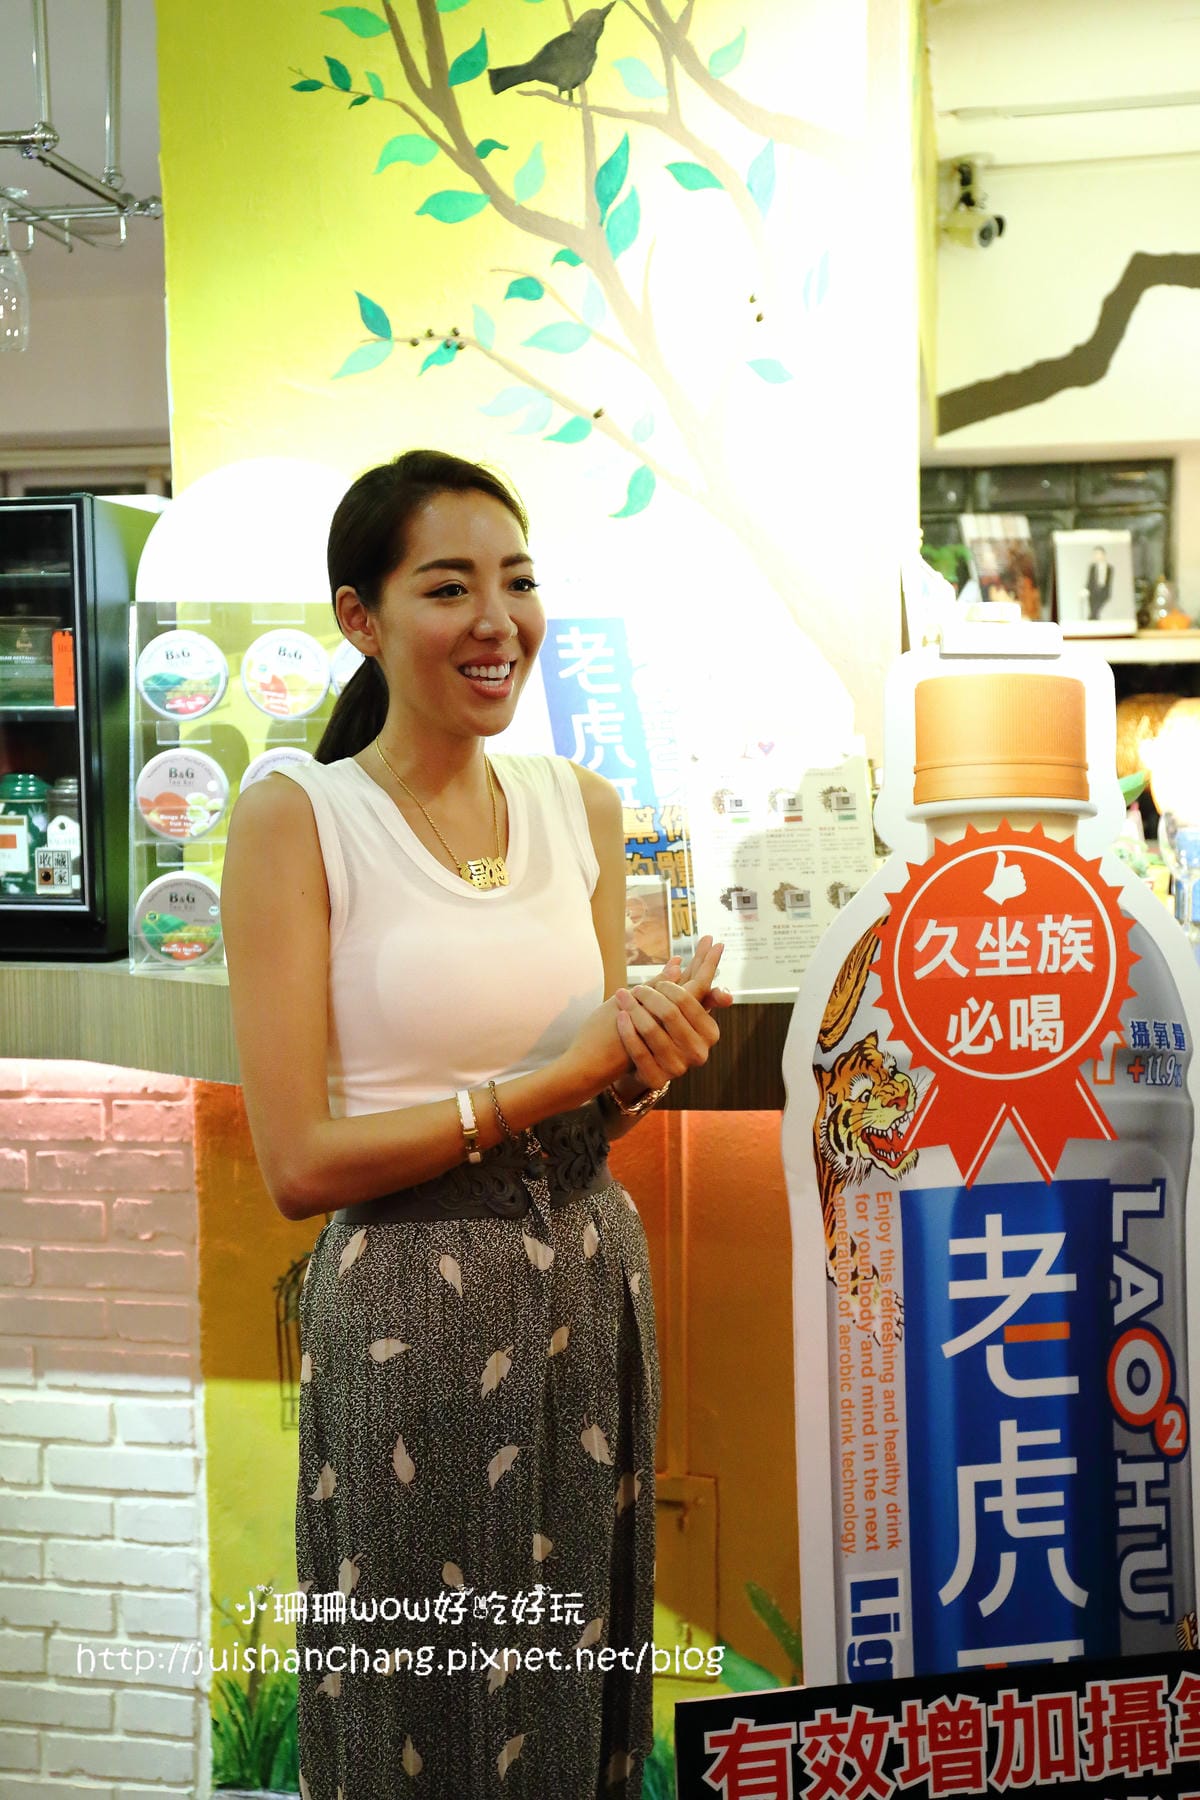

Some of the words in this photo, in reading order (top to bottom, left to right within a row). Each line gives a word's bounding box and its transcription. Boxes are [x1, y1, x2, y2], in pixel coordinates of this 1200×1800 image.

[556, 627, 642, 809] 老虎
[169, 767, 195, 779] B&G
[169, 893, 195, 904] B&G
[913, 913, 1095, 980] 久坐族
[946, 994, 1065, 1058] 必喝
[1130, 1020, 1186, 1051] 攝氧量
[854, 1193, 870, 1222] for
[874, 1191, 895, 1243] Enjoy
[854, 1229, 873, 1278] your
[879, 1250, 896, 1282] this
[838, 1298, 854, 1318] of
[856, 1281, 875, 1333] body
[839, 1325, 856, 1392] aerobic
[878, 1287, 899, 1383] refreshing
[861, 1340, 877, 1379] and
[840, 1397, 857, 1445] drink
[861, 1385, 878, 1437] mind
[883, 1389, 899, 1423] and
[863, 1443, 879, 1462] in
[881, 1429, 901, 1497] healthy
[938, 1213, 1089, 1668] 老虎
[864, 1468, 879, 1501] the
[865, 1507, 881, 1552] next
[886, 1502, 903, 1550] drink
